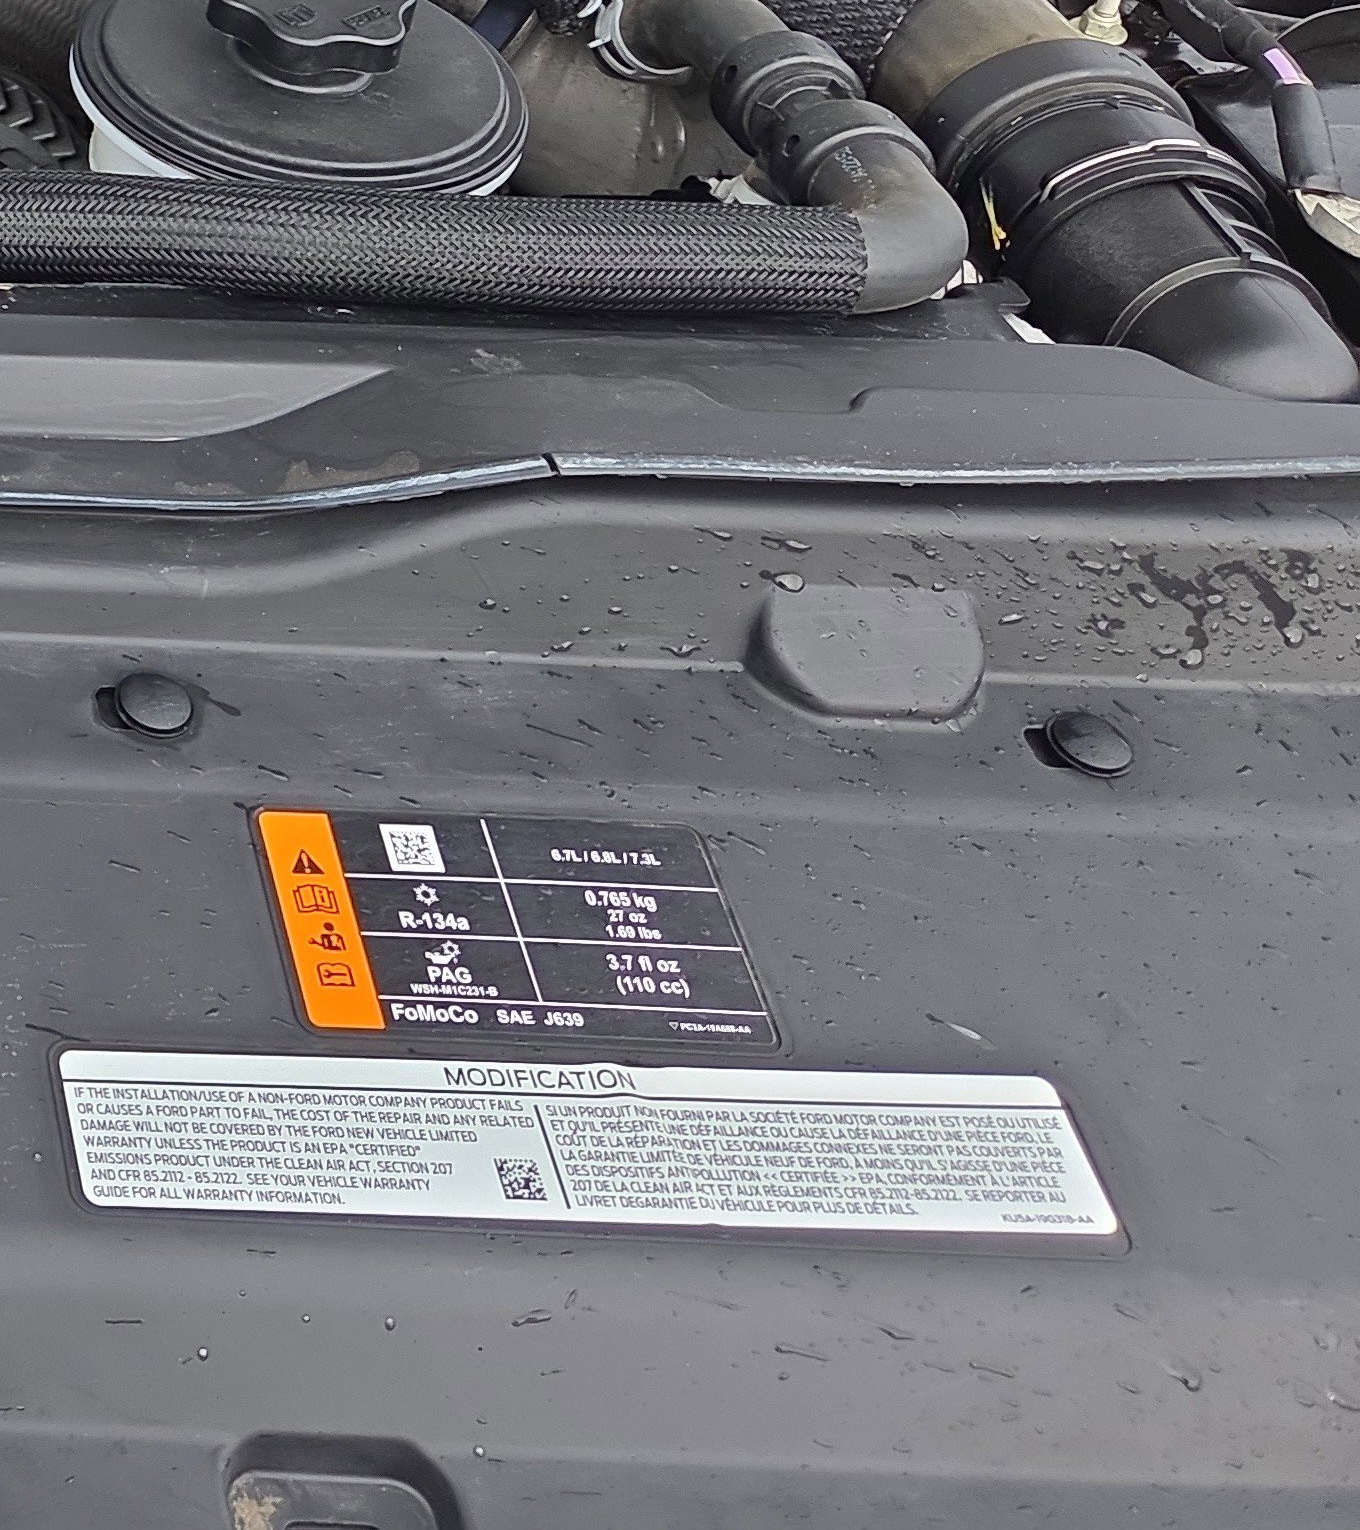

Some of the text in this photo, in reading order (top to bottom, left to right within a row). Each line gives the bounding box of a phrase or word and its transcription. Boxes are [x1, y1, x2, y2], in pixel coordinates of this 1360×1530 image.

[550, 848, 583, 863] 6.7L
[629, 852, 662, 866] 7.3L
[584, 889, 658, 913] 0.765 kg
[398, 910, 471, 931] R-134a
[607, 908, 648, 924] 27 oz
[605, 924, 663, 940] 1.69 lbs
[426, 965, 473, 984] PAG
[605, 953, 681, 973] 3.7 fl oz
[616, 975, 691, 1000] (110 cc)
[389, 1002, 585, 1027] FoMoCo SAE J639
[442, 1066, 637, 1091] MODIFICATION
[73, 1086, 524, 1111] IF THE INSTALLATION/USE OF A NON-FORD MOTOR COMPANY PRODUCT FAILS
[76, 1102, 95, 1115] OR
[95, 1103, 143, 1116] CAUSES
[143, 1104, 154, 1117] A
[154, 1104, 189, 1118] FORD
[189, 1105, 224, 1119] PART
[223, 1106, 242, 1119] TO
[272, 1108, 299, 1121] THE
[298, 1109, 332, 1122] COST
[332, 1110, 352, 1122] OF
[351, 1110, 378, 1123] THE
[377, 1111, 423, 1125] REPAIR
[422, 1112, 451, 1125] AND
[450, 1113, 479, 1126] ANY
[477, 1114, 536, 1128] RELATED
[544, 1103, 1064, 1131] SI UN PRODUIT NON FOURNI PAR LA SOCIÉTÉ FORD MOTOR COMPANY EST POSÉ OU UTILISÉ
[79, 1118, 479, 1143] DAMAGE WILL NOT BE COVERED BY THE FORD NEW VEHICLE LIMITED
[82, 1135, 154, 1149] WARRANTY
[153, 1137, 203, 1150] UNLESS
[202, 1138, 229, 1151] THE
[229, 1139, 288, 1153] PRODUCT
[288, 1140, 302, 1153] IS
[301, 1141, 322, 1154] AN
[321, 1141, 349, 1155] EPA
[85, 1151, 152, 1165] EMISSIONS
[152, 1153, 212, 1167] PRODUCT
[212, 1155, 256, 1168] UNDER
[255, 1156, 283, 1169] THE
[282, 1157, 324, 1170] CLEAN
[324, 1158, 347, 1171] AIR
[375, 1160, 430, 1174] SECTION
[429, 1161, 455, 1175] 207
[88, 1168, 116, 1181] AND
[116, 1168, 141, 1182] CFR
[142, 1169, 186, 1183] 85.2112
[245, 1172, 271, 1186] SEE
[269, 1173, 306, 1187] YOUR
[306, 1174, 360, 1188] VEHICLE
[358, 1176, 432, 1190] WARRANTY
[92, 1184, 346, 1204] GUIDE FOR ALL WARRANTY INFORMATION.
